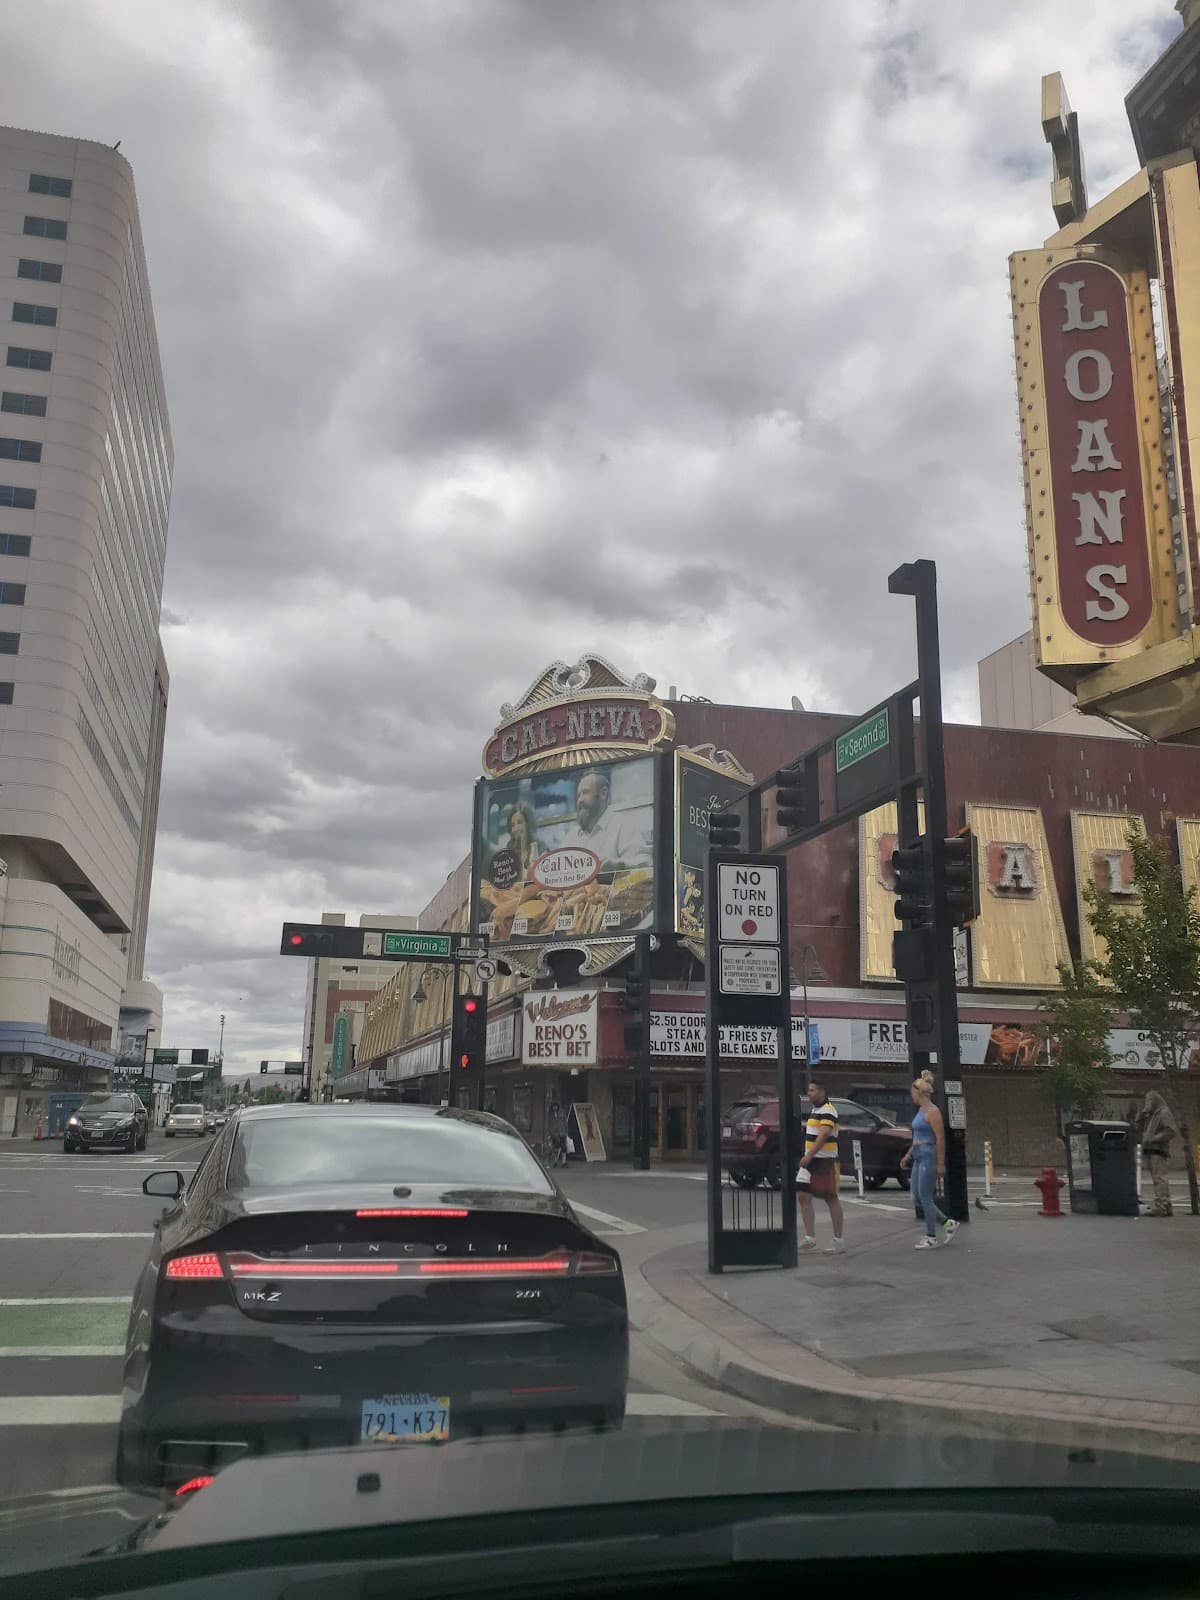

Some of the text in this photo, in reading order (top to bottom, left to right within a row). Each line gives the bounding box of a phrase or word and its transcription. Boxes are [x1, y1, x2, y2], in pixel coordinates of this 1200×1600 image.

[1058, 279, 1131, 622] LOANS
[501, 703, 646, 764] CAL NEVA
[849, 722, 878, 757] Second
[541, 855, 593, 874] Cal Neva
[1000, 847, 1035, 890] A
[736, 871, 760, 885] NO
[732, 889, 766, 901] TURN
[725, 904, 773, 917] ON RED
[400, 939, 438, 953] Virginia
[525, 993, 597, 1024] Welcome
[650, 1015, 706, 1027] $2.50 COOR
[535, 1024, 587, 1041] RENO'S
[666, 1028, 700, 1040] STEAK
[729, 1030, 757, 1042] FRIES
[529, 1041, 591, 1057] BEST BET
[649, 1041, 680, 1053] SLOTS
[684, 1041, 705, 1053] AND
[718, 1042, 739, 1053] BLE
[741, 1043, 775, 1055] GAMES
[869, 1042, 908, 1053] PARKIN
[305, 1243, 508, 1252] LINCOLN
[243, 1292, 282, 1301] MKZ
